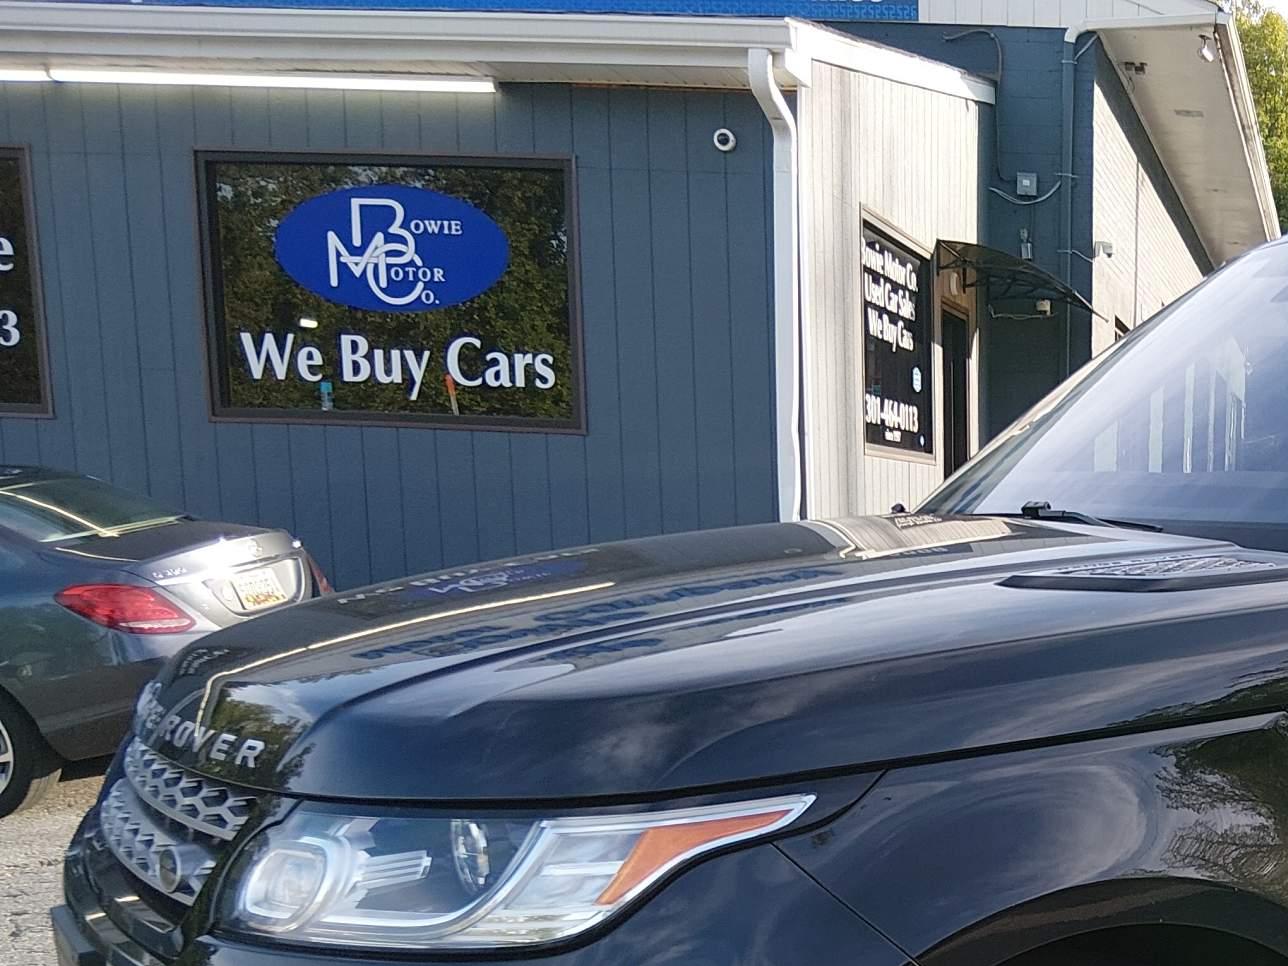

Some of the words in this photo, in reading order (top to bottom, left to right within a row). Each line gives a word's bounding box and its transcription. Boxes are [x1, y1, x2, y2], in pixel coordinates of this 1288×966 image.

[864, 273, 885, 307] Used
[867, 307, 882, 339] We
[882, 314, 897, 352] Buy
[241, 332, 323, 382] We
[341, 334, 430, 401] Buy
[447, 337, 556, 389] Cars
[158, 714, 267, 769] ROVER
